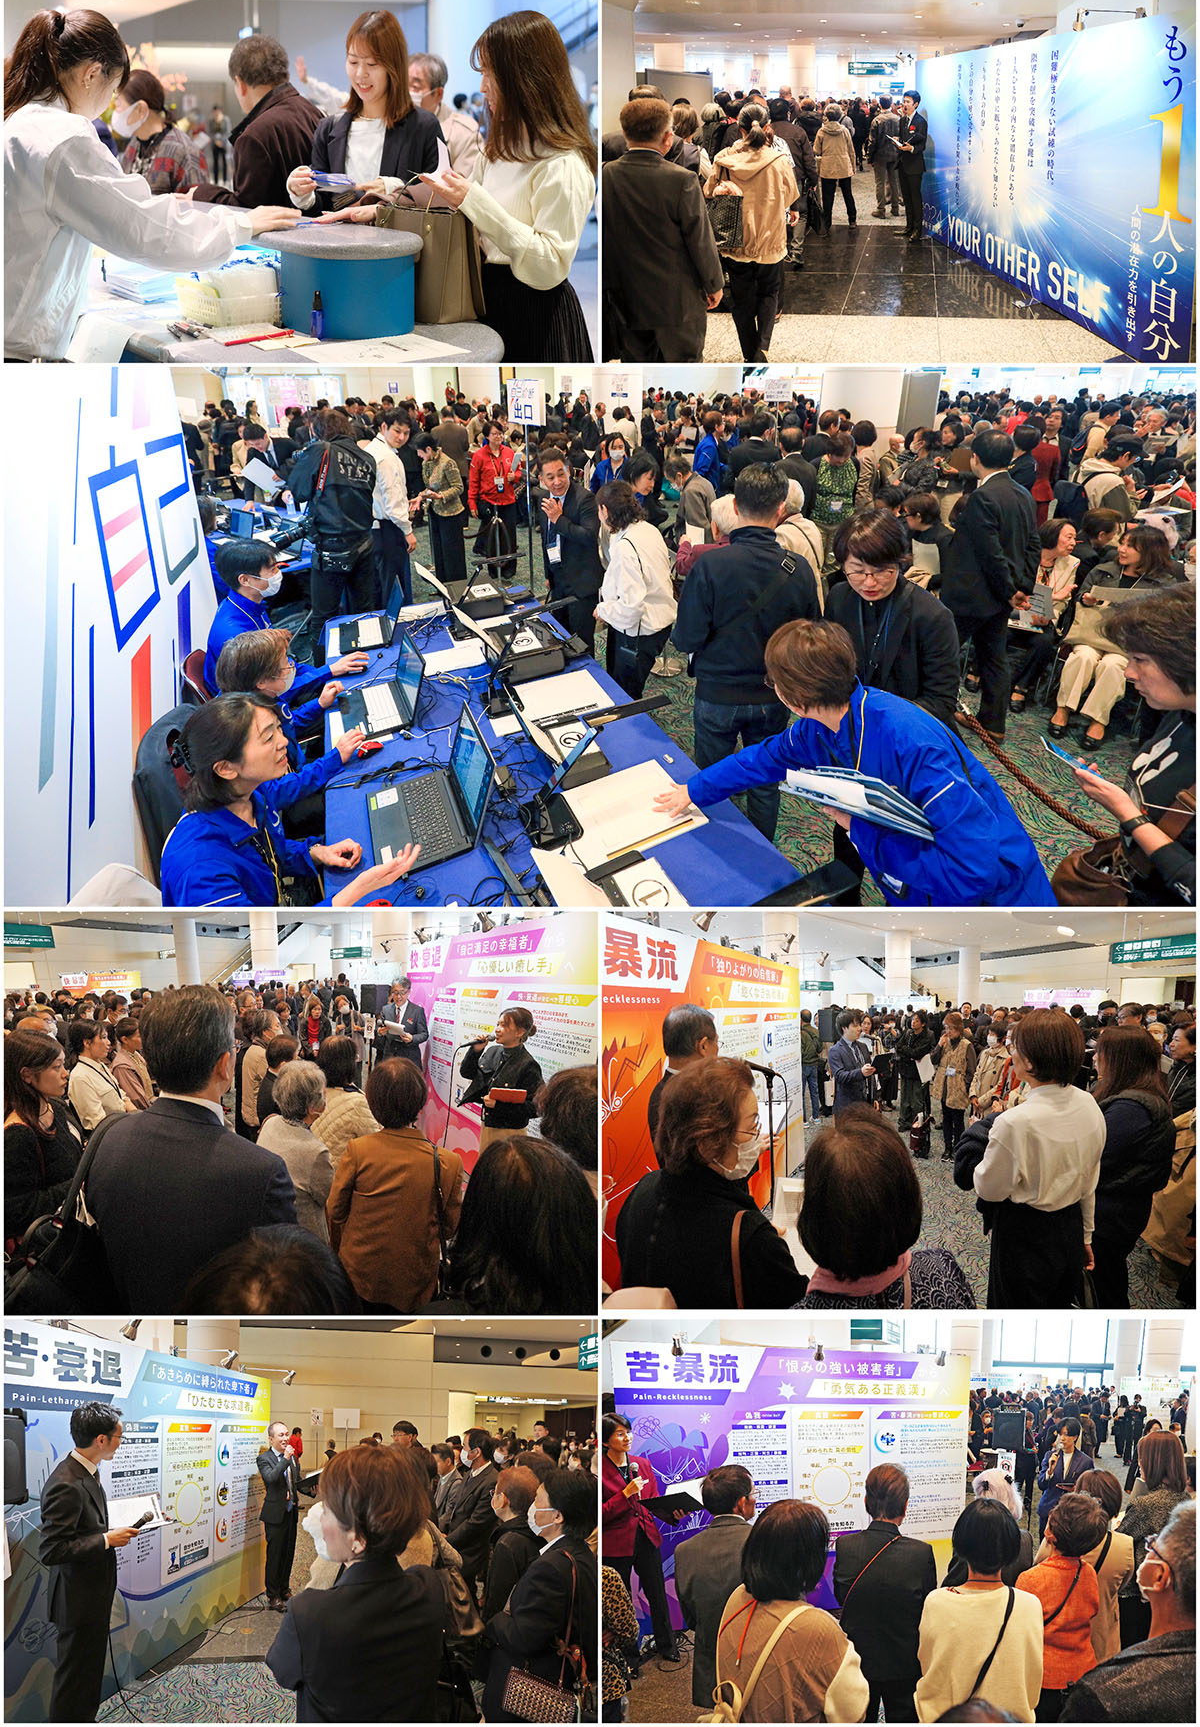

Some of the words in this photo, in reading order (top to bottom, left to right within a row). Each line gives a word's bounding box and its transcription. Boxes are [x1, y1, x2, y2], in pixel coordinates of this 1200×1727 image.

[1142, 25, 1193, 361] もう1人の自分
[948, 214, 981, 259] YOUR
[985, 233, 1040, 291] OTHER
[1047, 261, 1110, 324] SELF
[1126, 204, 1142, 342] 人間の潜在力を引き出す
[456, 934, 534, 957] 「自己満足の幸福者」
[604, 926, 679, 982] 暴流
[477, 958, 553, 975] 「心優しい癒し手」
[603, 994, 661, 1005] ecklessness
[625, 1351, 740, 1384] 苦・暴流
[778, 1359, 902, 1377] 「恨みの強い被害者」
[152, 1363, 254, 1397] 「あきらめに縛られた卑下者」
[823, 1382, 926, 1396] 「勇気ある正義漢」
[12, 1392, 85, 1406] Pain-Lethargy
[187, 1393, 254, 1413] 「ひたむきな求道者」
[633, 1393, 712, 1401] Pain-Recklessness
